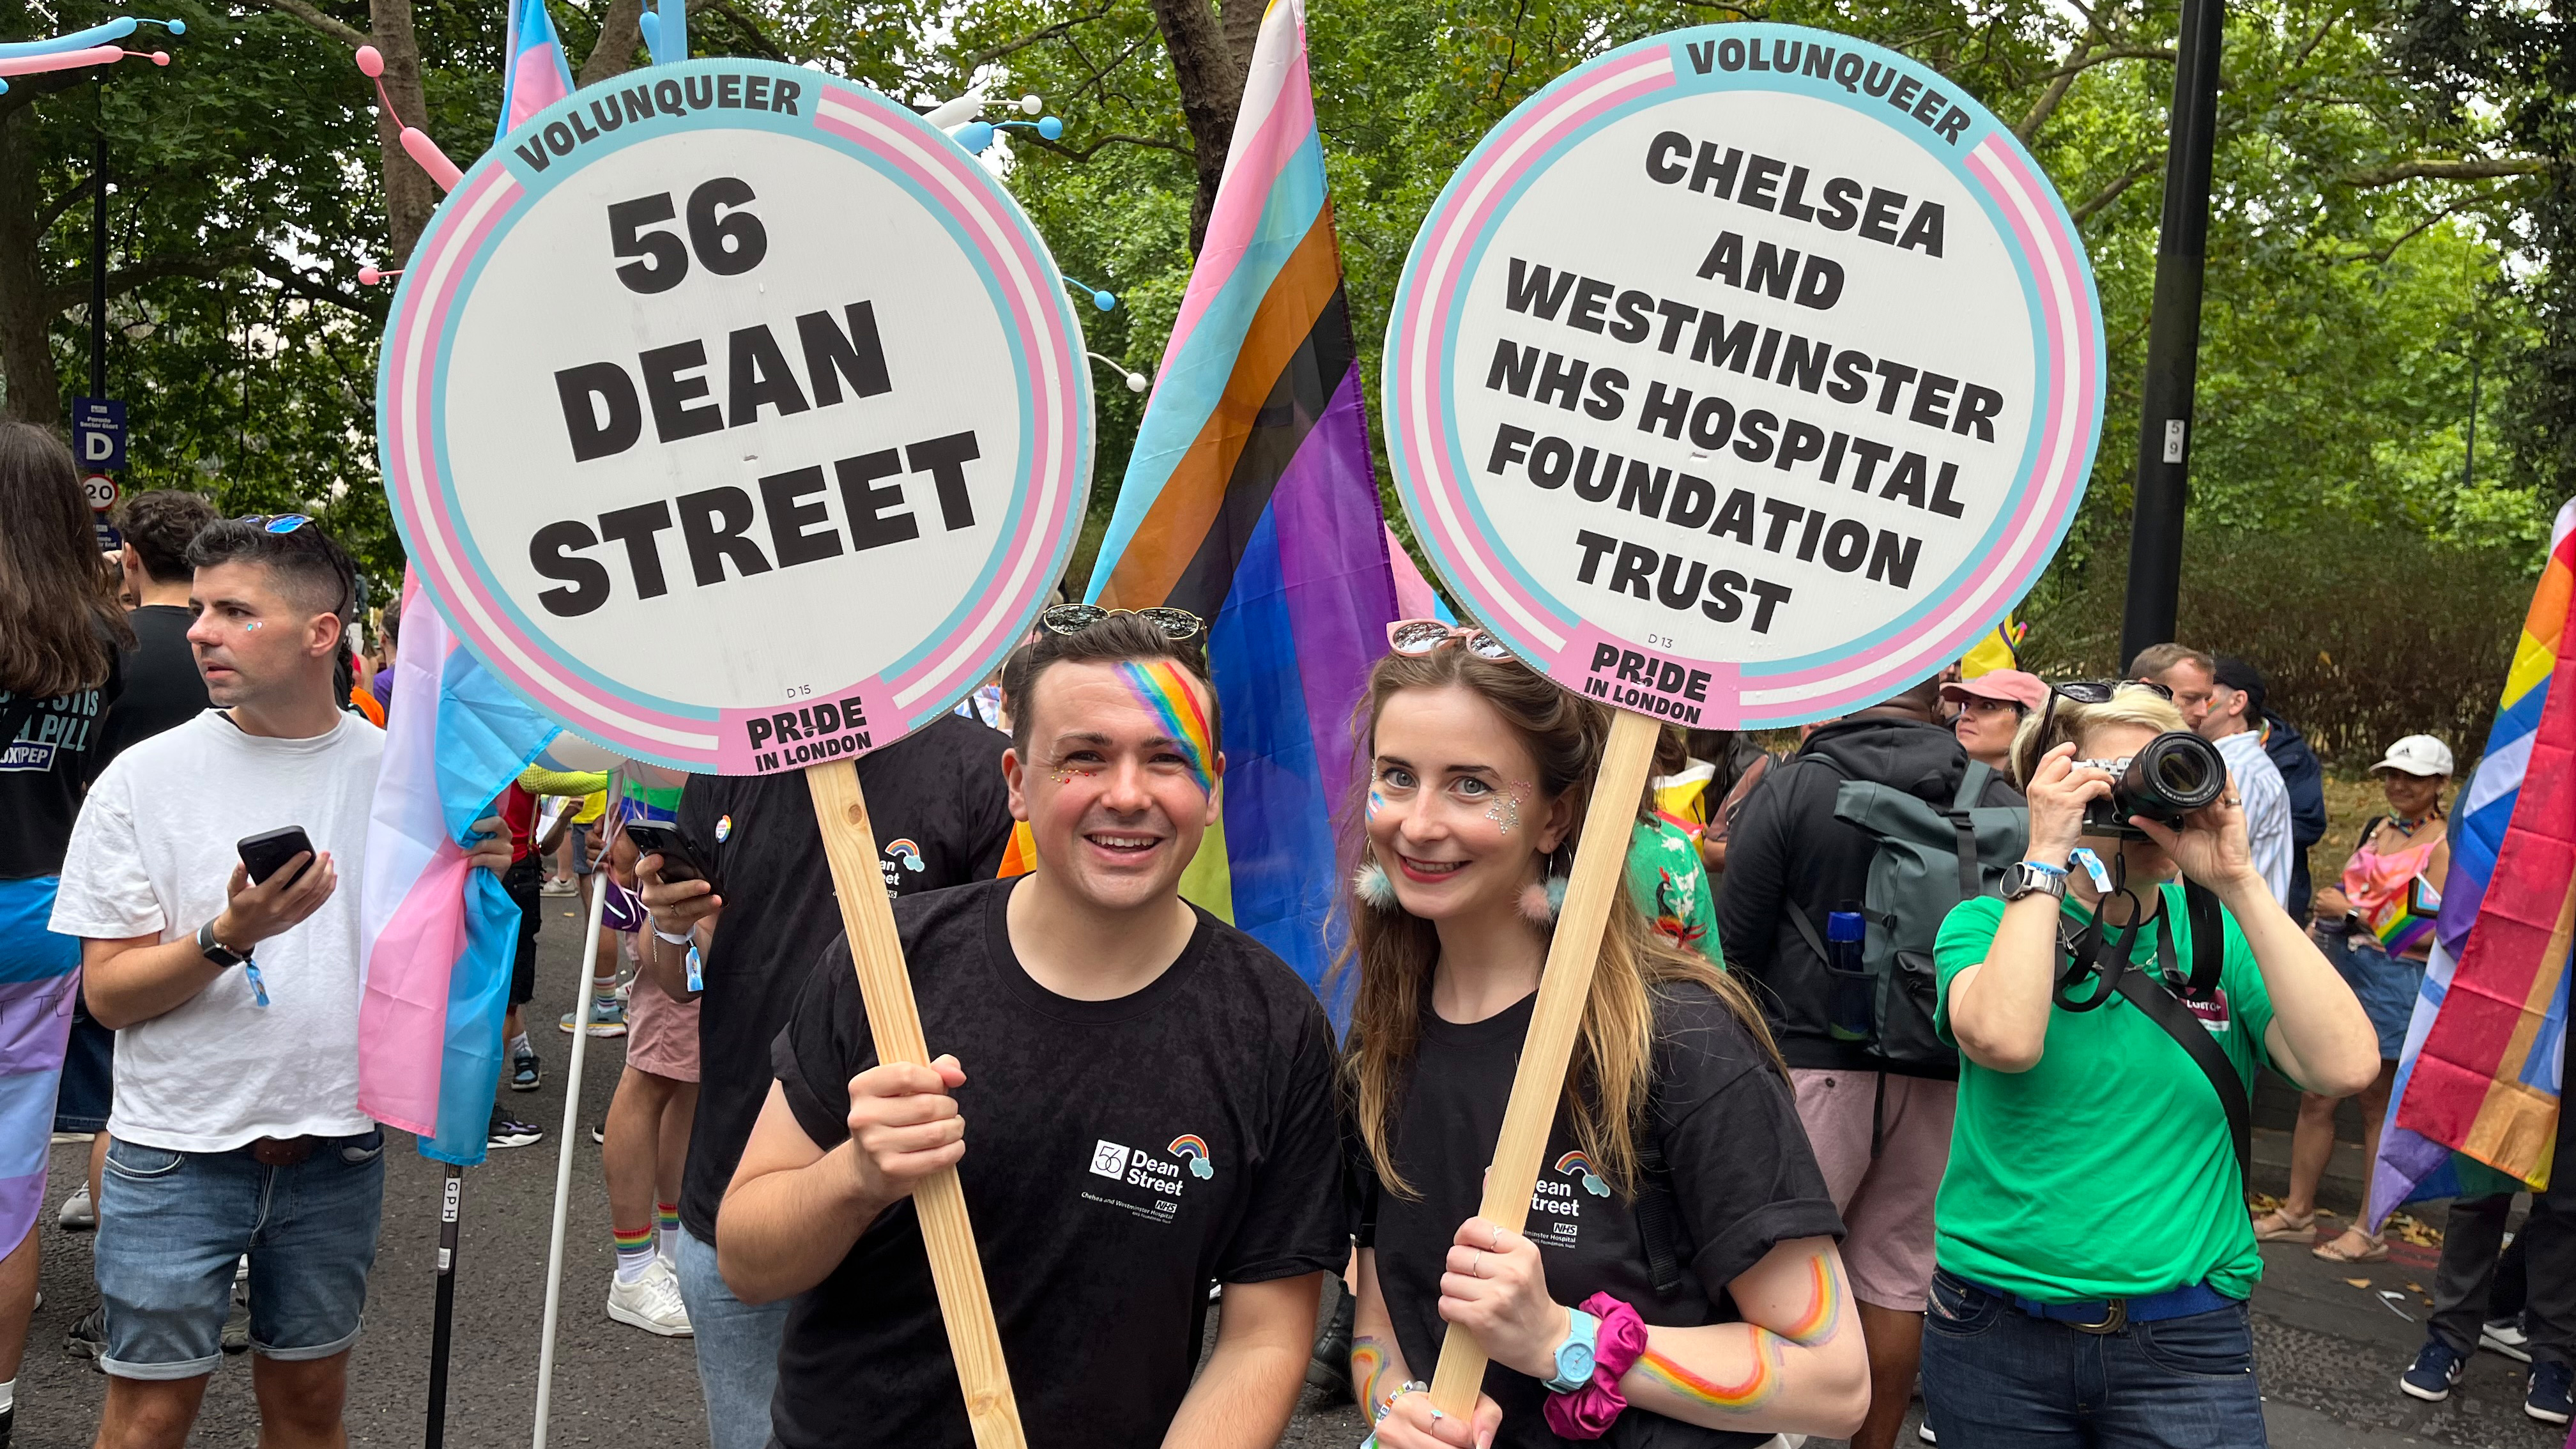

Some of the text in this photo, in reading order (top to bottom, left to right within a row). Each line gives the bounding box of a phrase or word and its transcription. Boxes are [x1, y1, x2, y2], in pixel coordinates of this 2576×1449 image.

[1686, 37, 1970, 146] VOLUNQUEER
[514, 74, 802, 172] VOLUNQUEER
[1645, 131, 1946, 258] CHELSEA
[608, 177, 768, 294] 56
[1696, 231, 1844, 311] AND
[1506, 257, 2004, 444] WESTMINSTER
[553, 300, 892, 463] DEAN
[1485, 338, 1967, 519] NHS HOSPITAL
[86, 431, 113, 460] D
[86, 484, 112, 500] 20
[1485, 423, 1922, 590] FOUNDATION
[528, 431, 981, 618] STREET
[1575, 529, 1791, 634] TRUST
[1648, 634, 1673, 648] D 13
[787, 685, 811, 698] D 15
[1584, 677, 1701, 724] IN LONDON
[38, 714, 90, 752] PILL
[755, 732, 871, 772] IN LONDON
[880, 860, 895, 871] an
[1096, 1146, 1121, 1173] 56
[1131, 1149, 1179, 1177] Dean
[1126, 1169, 1183, 1197] Street
[1536, 1179, 1571, 1197] ean
[1081, 1192, 1103, 1202] Chelsea
[1116, 1199, 1150, 1214] Westminster
[1157, 1201, 1175, 1212] NHS
[1532, 1193, 1579, 1216] treet
[1524, 1230, 1576, 1243] tminster Hospital
[1554, 1223, 1575, 1234] NHS
